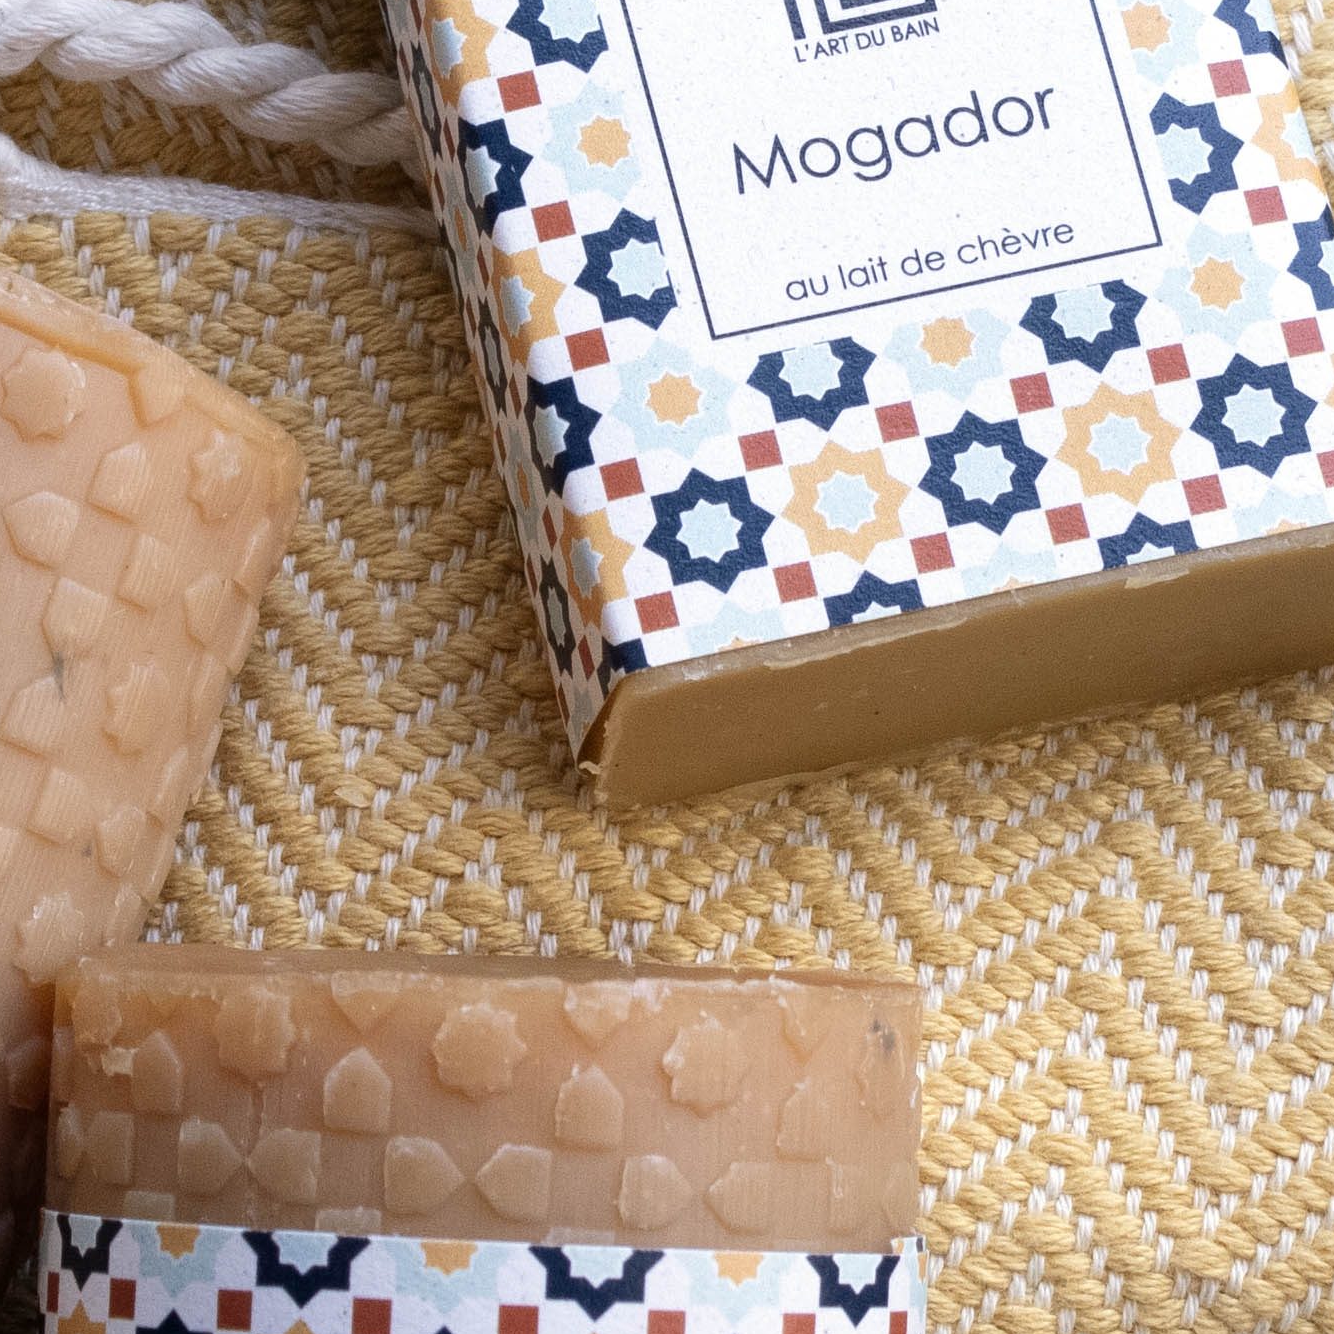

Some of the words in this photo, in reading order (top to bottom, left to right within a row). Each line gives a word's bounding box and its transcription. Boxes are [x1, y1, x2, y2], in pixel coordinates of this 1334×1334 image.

[793, 35, 849, 63] L'ART
[854, 28, 886, 51] DU
[889, 15, 940, 43] BAIN
[733, 88, 1054, 195] Mogador
[785, 275, 829, 301] au
[837, 256, 888, 290] lait
[900, 248, 945, 277] de
[957, 223, 1076, 262] chèvre
